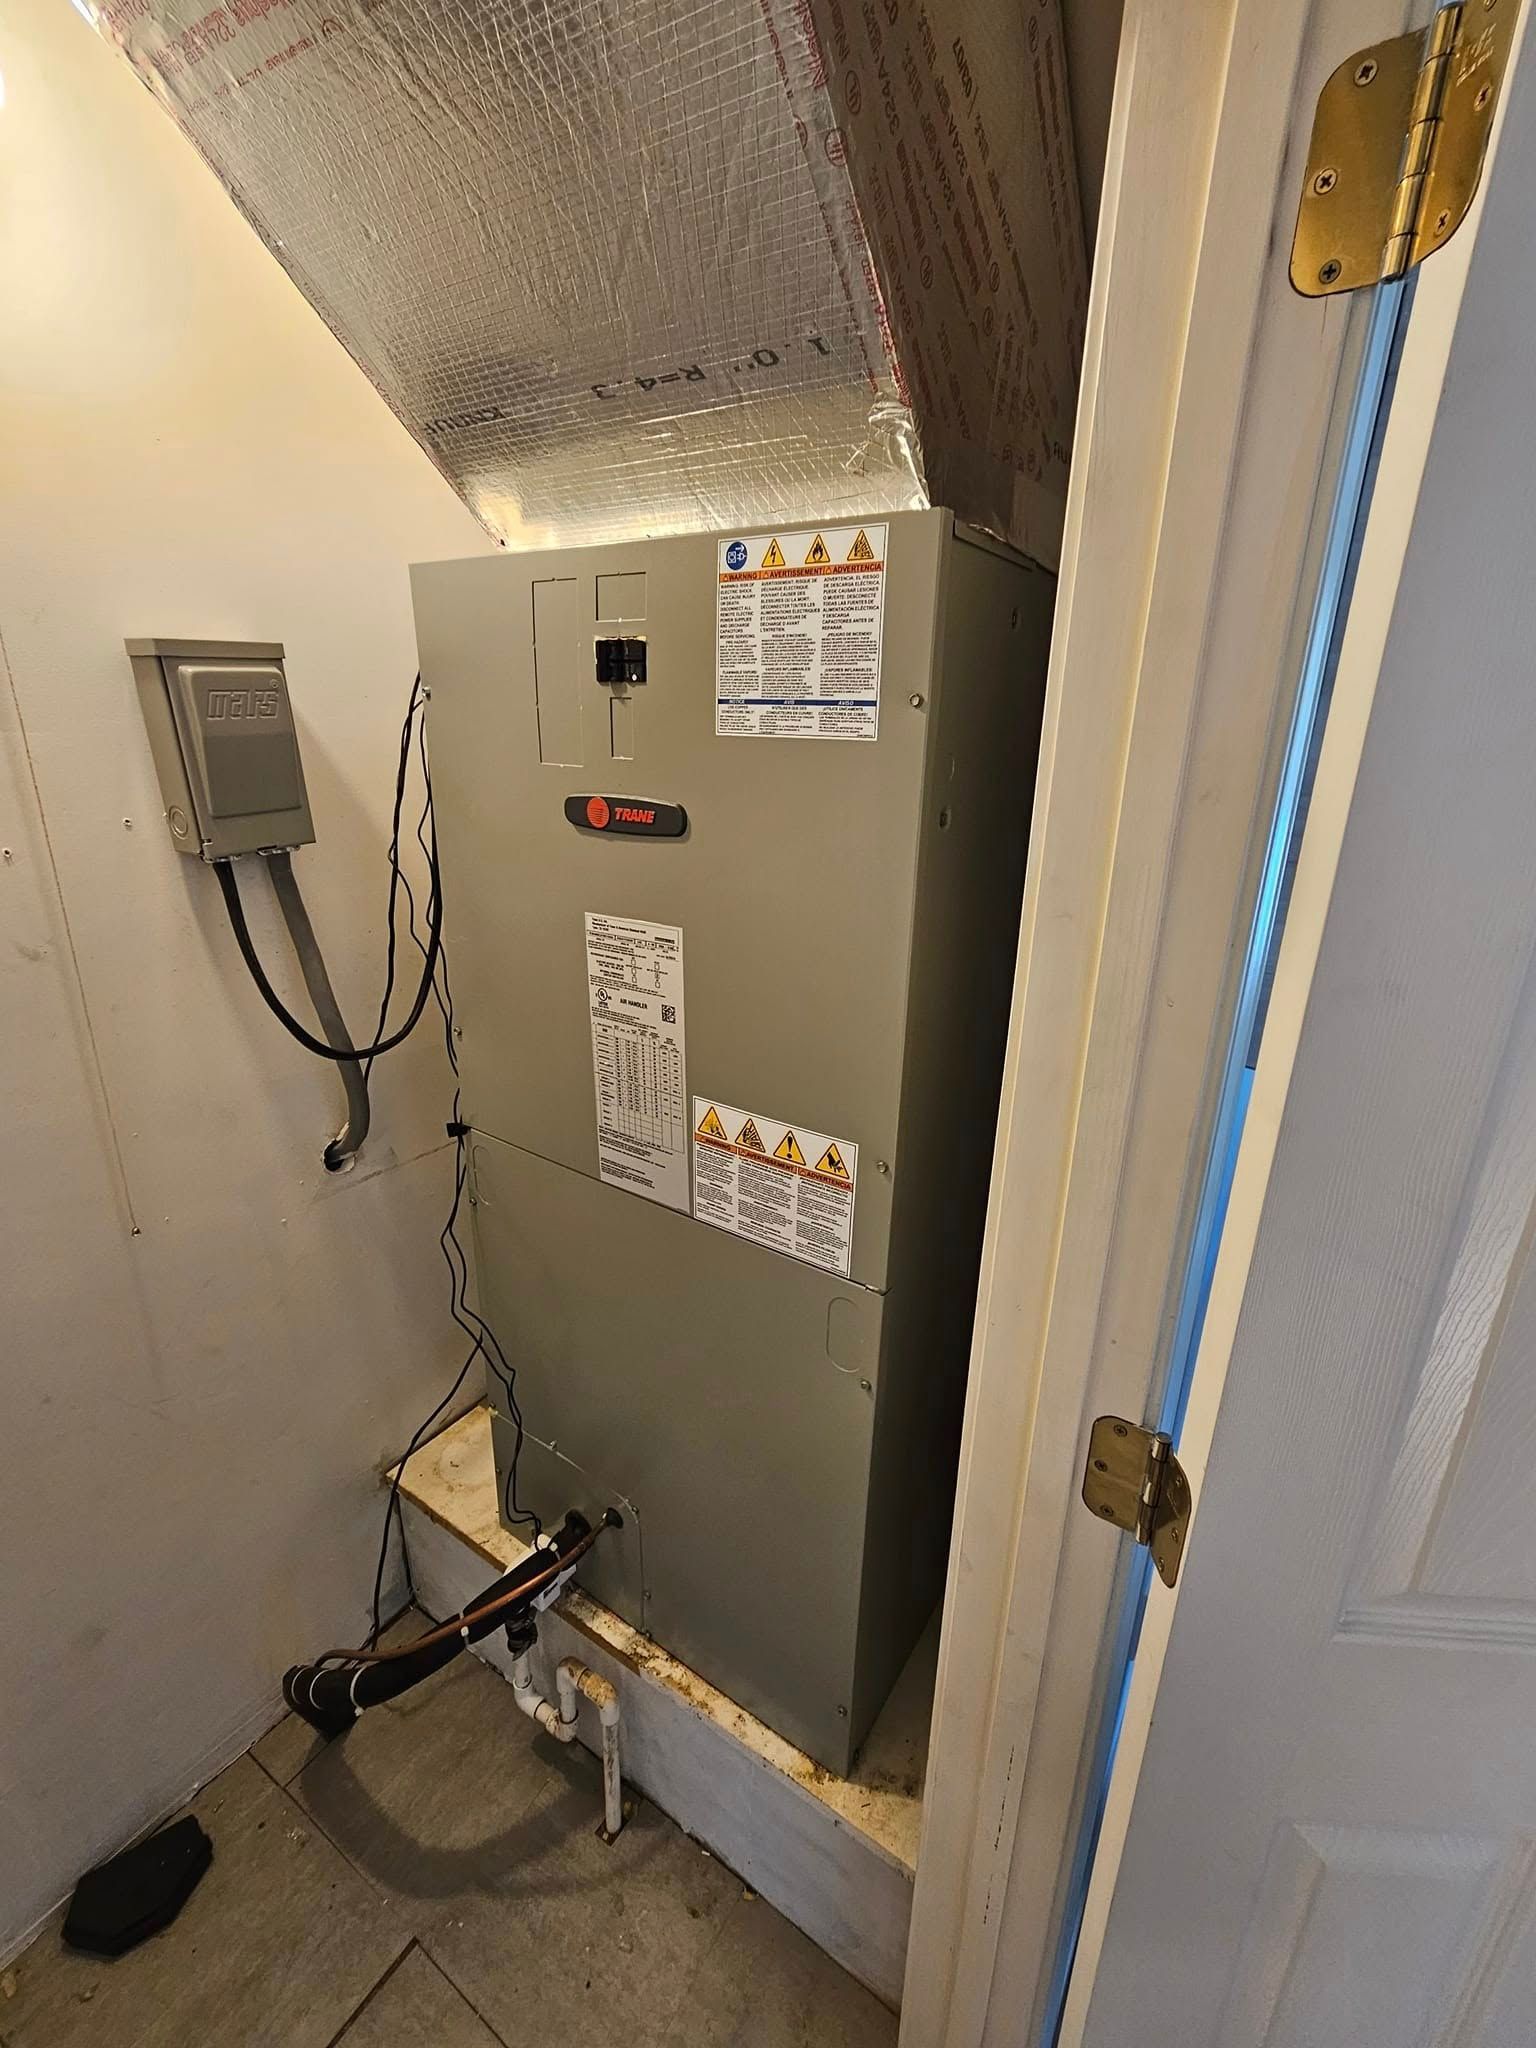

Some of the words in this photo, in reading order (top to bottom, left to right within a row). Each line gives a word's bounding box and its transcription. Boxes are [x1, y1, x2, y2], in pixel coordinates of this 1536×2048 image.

[591, 363, 706, 400] R=4.3
[770, 567, 821, 577] AVERTISSEMENT
[832, 562, 881, 573] ADVERTENCIA
[729, 572, 756, 580] WARNING
[615, 807, 655, 823] TRANE
[807, 1172, 852, 1191] ADVERTENCIA
